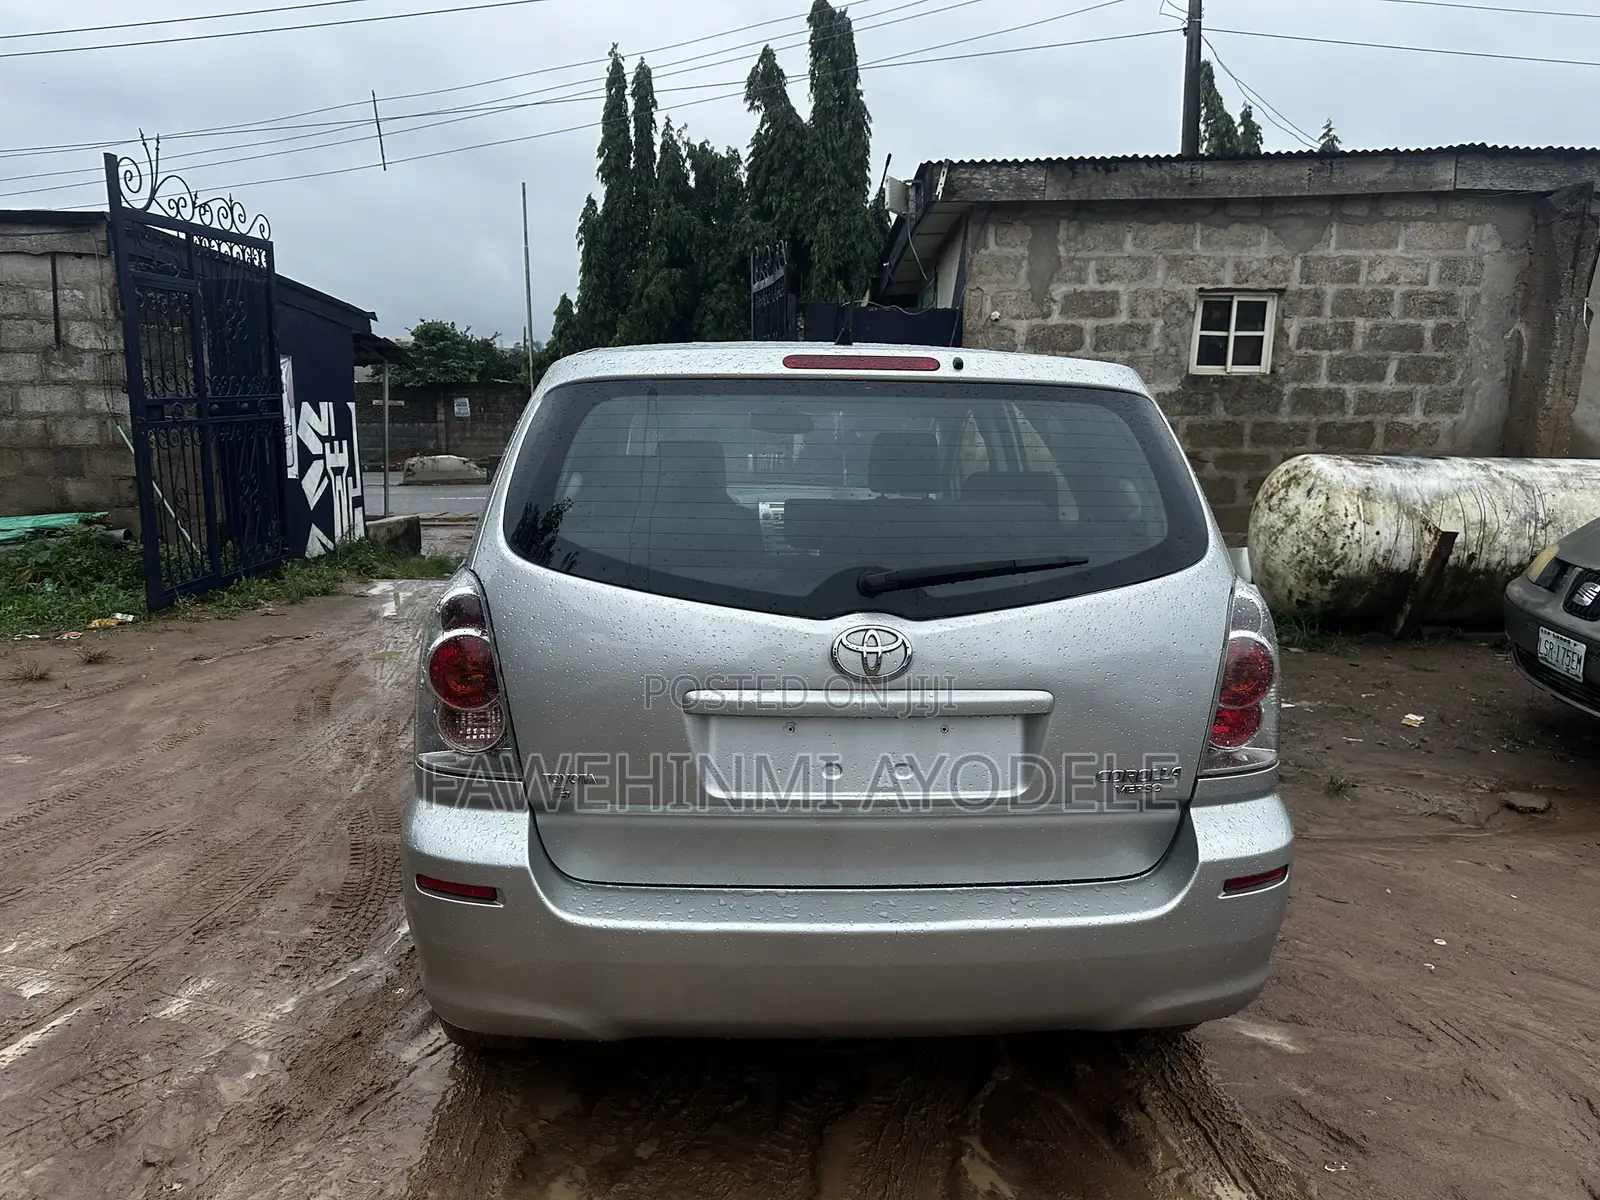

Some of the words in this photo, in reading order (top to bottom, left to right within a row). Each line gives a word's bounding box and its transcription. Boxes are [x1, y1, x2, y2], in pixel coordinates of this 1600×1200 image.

[542, 773, 599, 785] TOYOTA
[1096, 766, 1182, 783] COROLLA
[1114, 782, 1163, 795] VERSO
